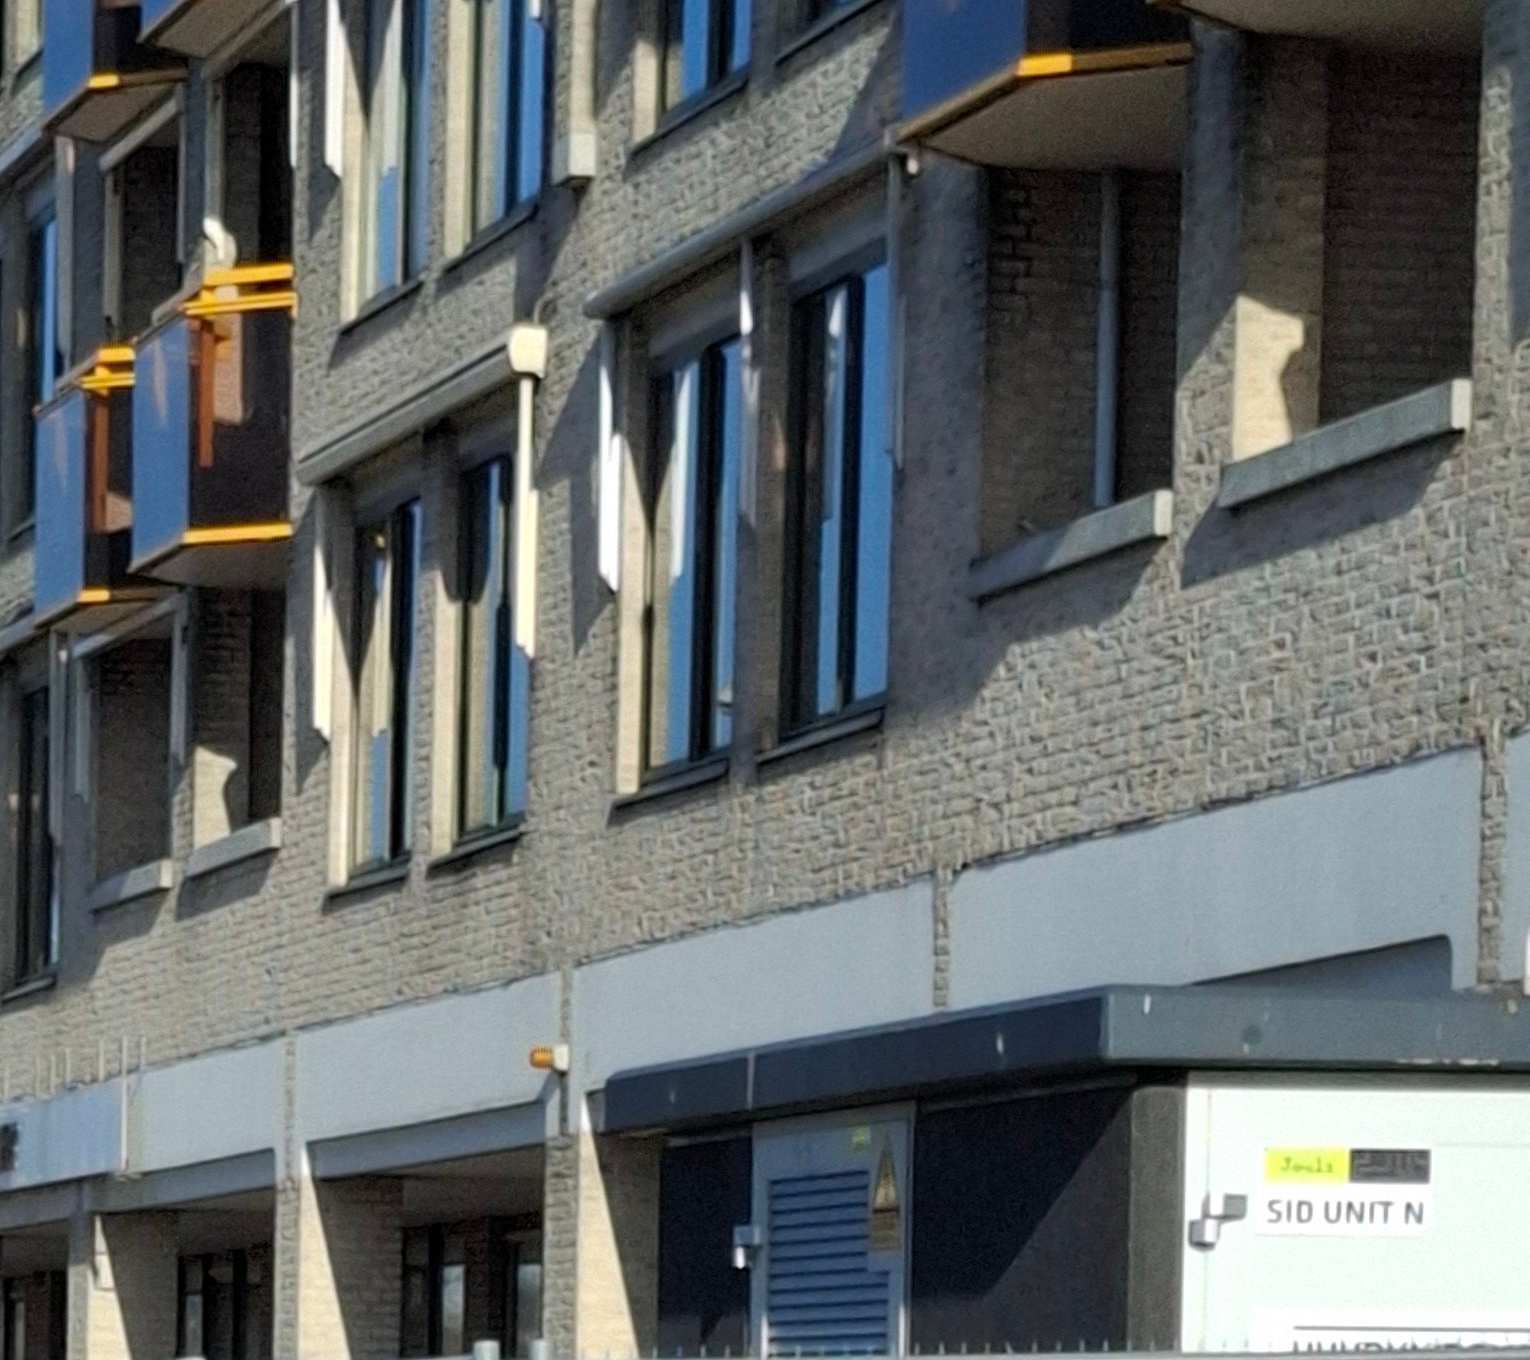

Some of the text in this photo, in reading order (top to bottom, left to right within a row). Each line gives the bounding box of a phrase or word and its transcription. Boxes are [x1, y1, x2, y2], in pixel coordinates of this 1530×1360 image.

[1267, 1199, 1424, 1225] SID UNIT N
